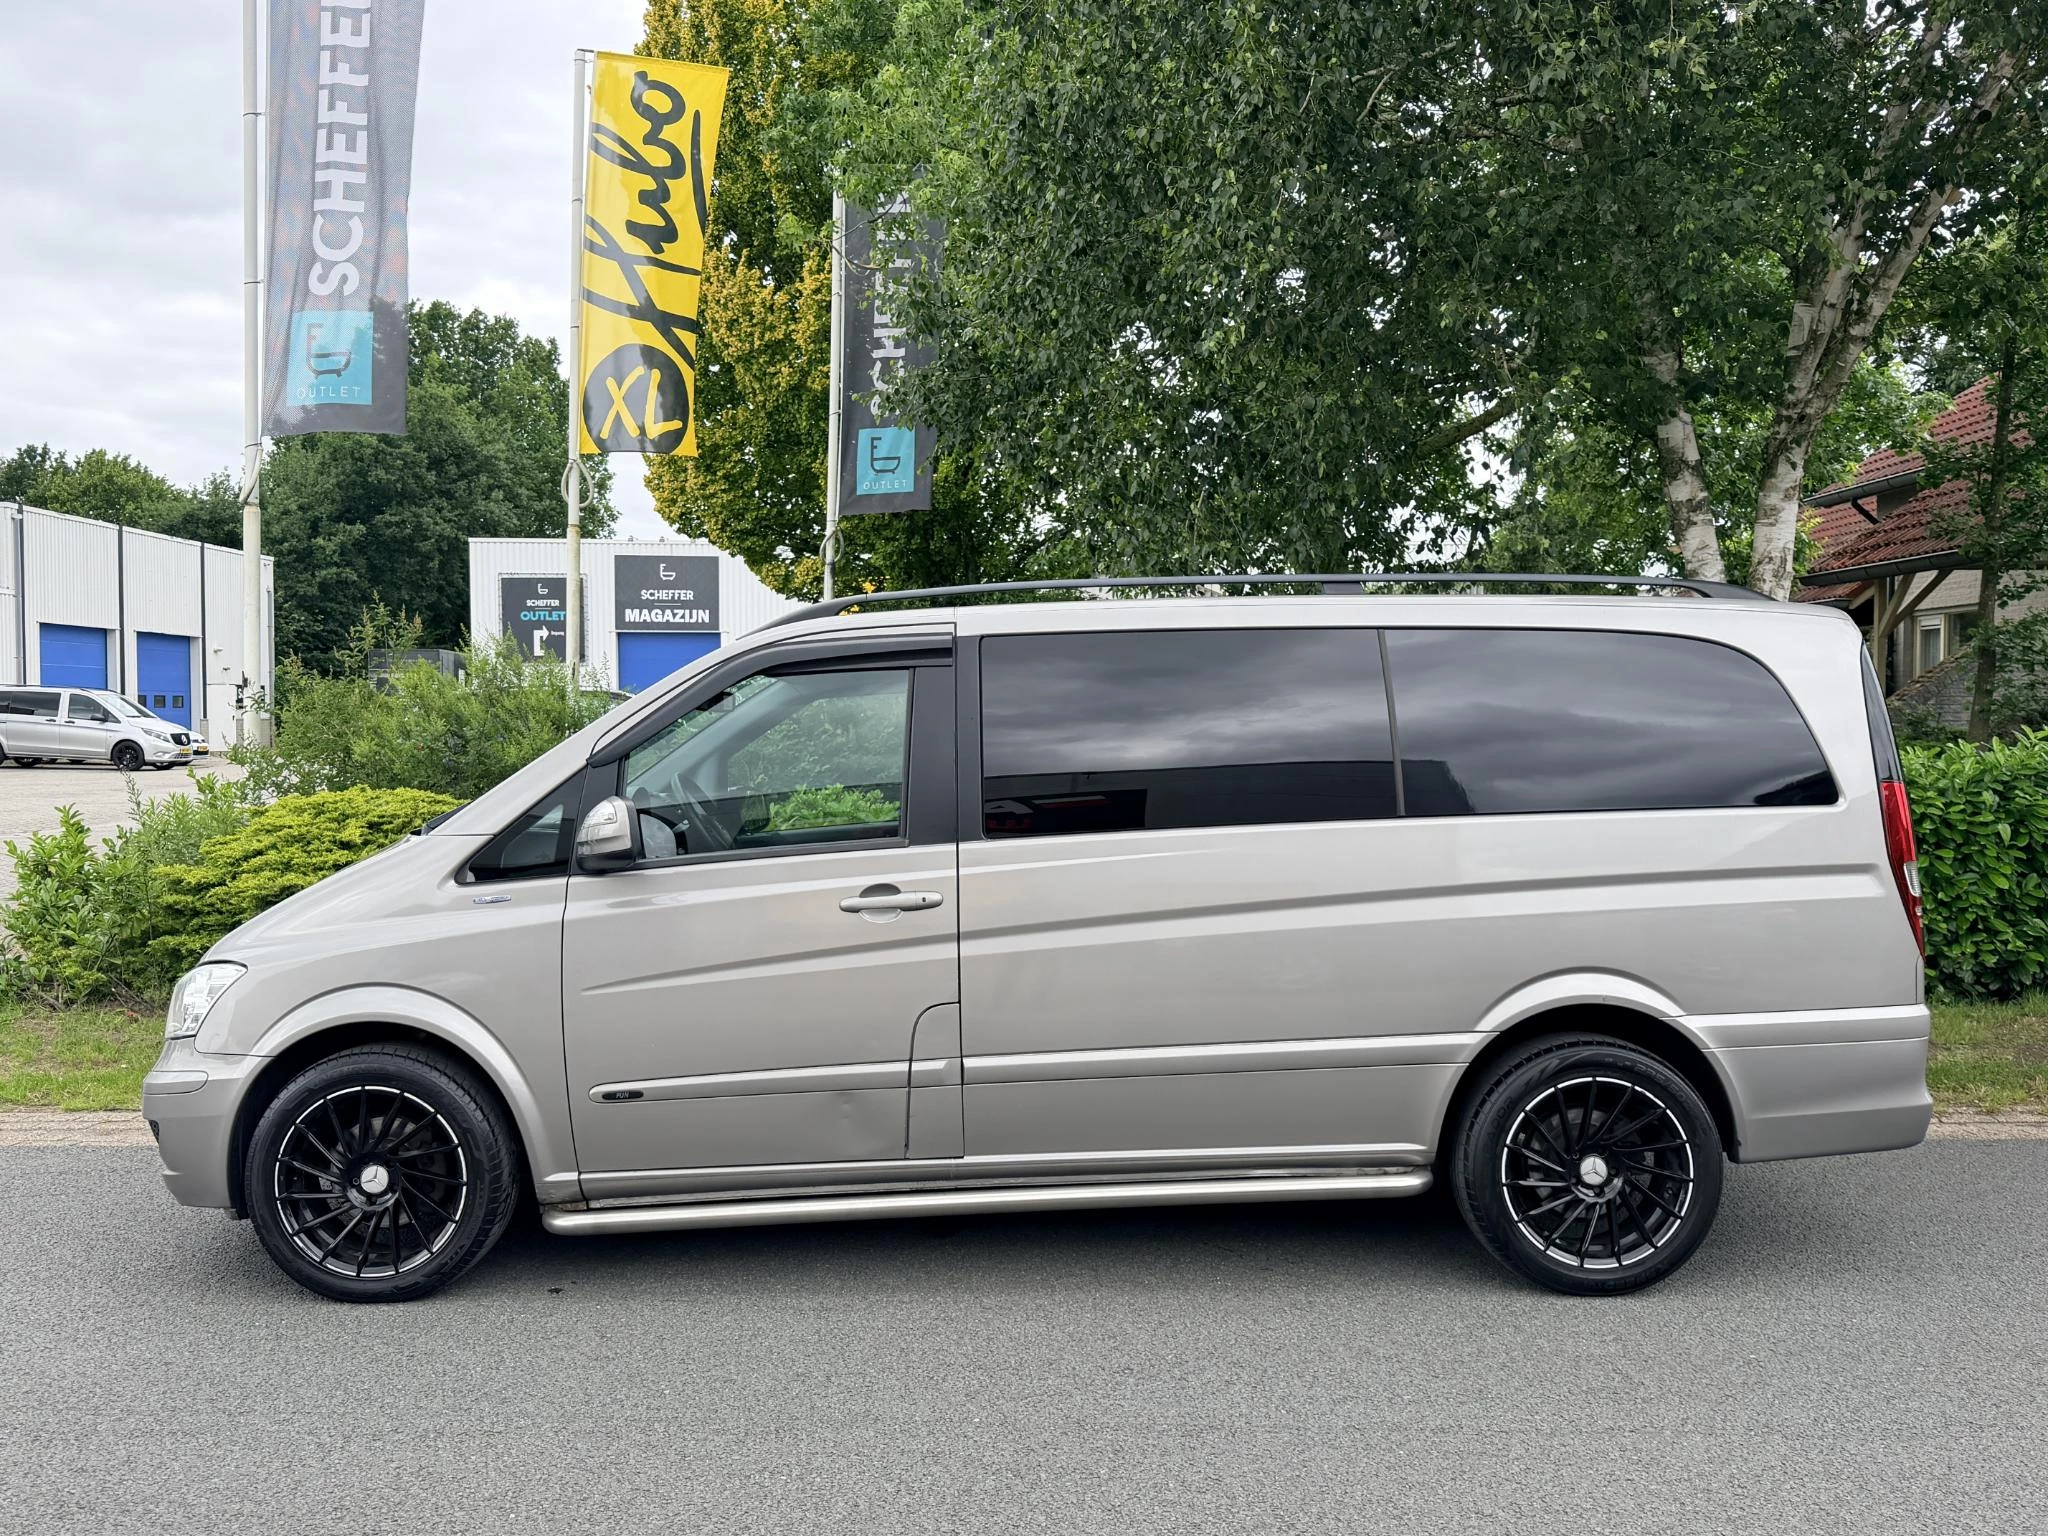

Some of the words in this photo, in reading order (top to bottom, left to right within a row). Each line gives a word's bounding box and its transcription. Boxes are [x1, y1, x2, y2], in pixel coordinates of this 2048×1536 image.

[308, 0, 371, 296] SCHEFFE
[583, 70, 701, 371] Hubo
[297, 386, 361, 399] OUTLET
[600, 366, 682, 440] XL
[863, 479, 908, 490] OUTLET
[640, 589, 694, 601] SCHEFFER
[520, 611, 566, 621] OUTLET
[624, 608, 710, 623] MAGAZIJN
